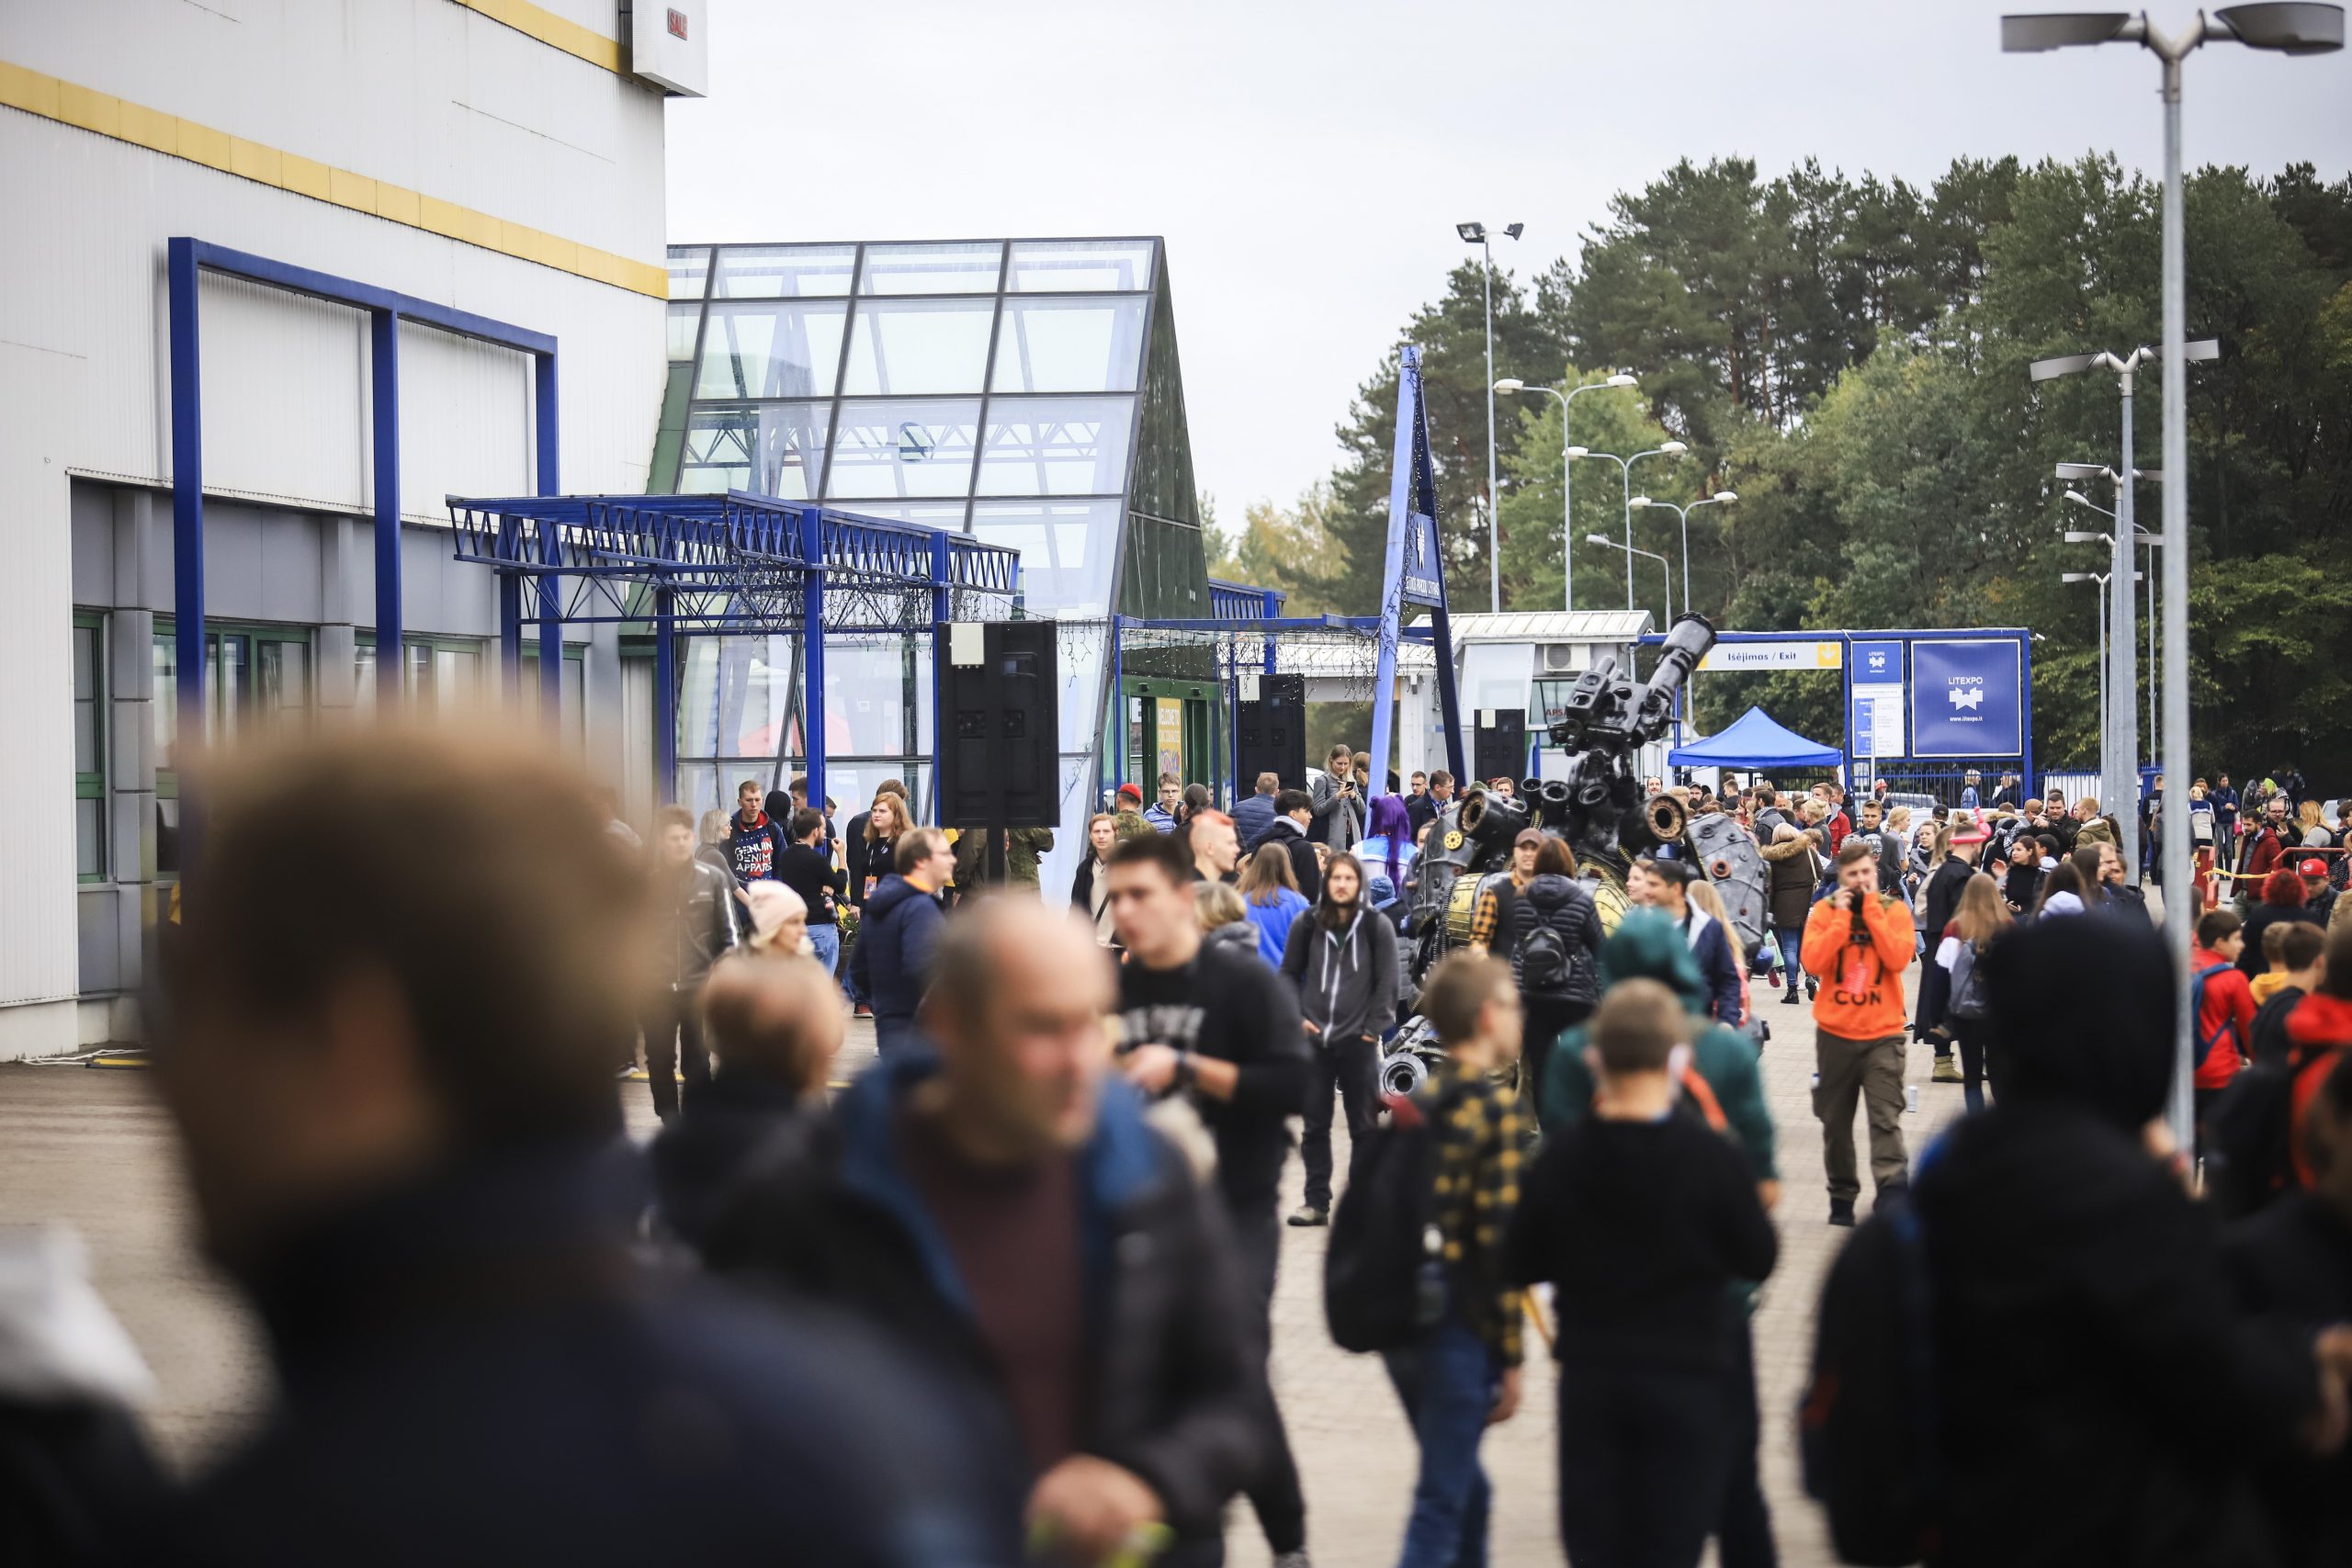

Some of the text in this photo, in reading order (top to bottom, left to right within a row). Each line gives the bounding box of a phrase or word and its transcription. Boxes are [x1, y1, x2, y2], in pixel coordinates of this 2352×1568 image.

[1728, 651, 1769, 662] Išėjimas
[1779, 651, 1796, 660] Exit
[1948, 676, 1984, 685] LITEXPO
[735, 840, 774, 855] GENUIN
[736, 852, 771, 863] DENIM
[1834, 989, 1882, 1007] CON
